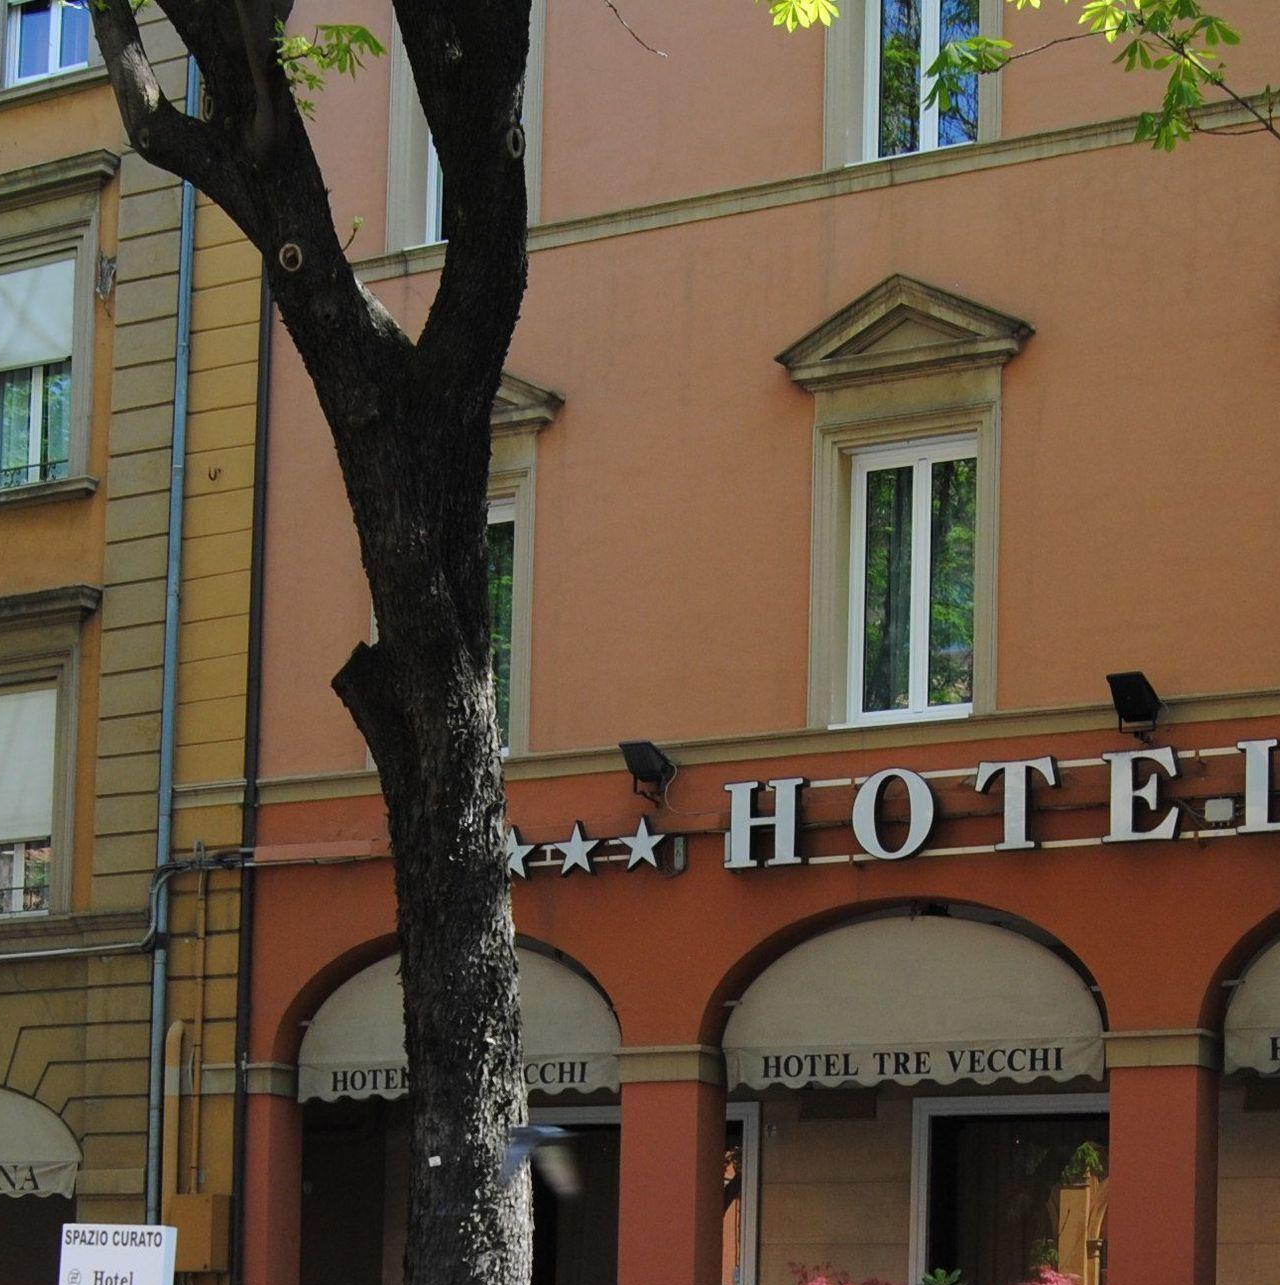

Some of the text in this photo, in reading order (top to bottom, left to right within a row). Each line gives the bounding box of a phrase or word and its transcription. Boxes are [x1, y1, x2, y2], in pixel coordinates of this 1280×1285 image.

[523, 1061, 588, 1085] CCHI
[762, 1047, 1064, 1079] HOTEL TRE VECCHI
[65, 1230, 163, 1247] SPAZIO CURATO
